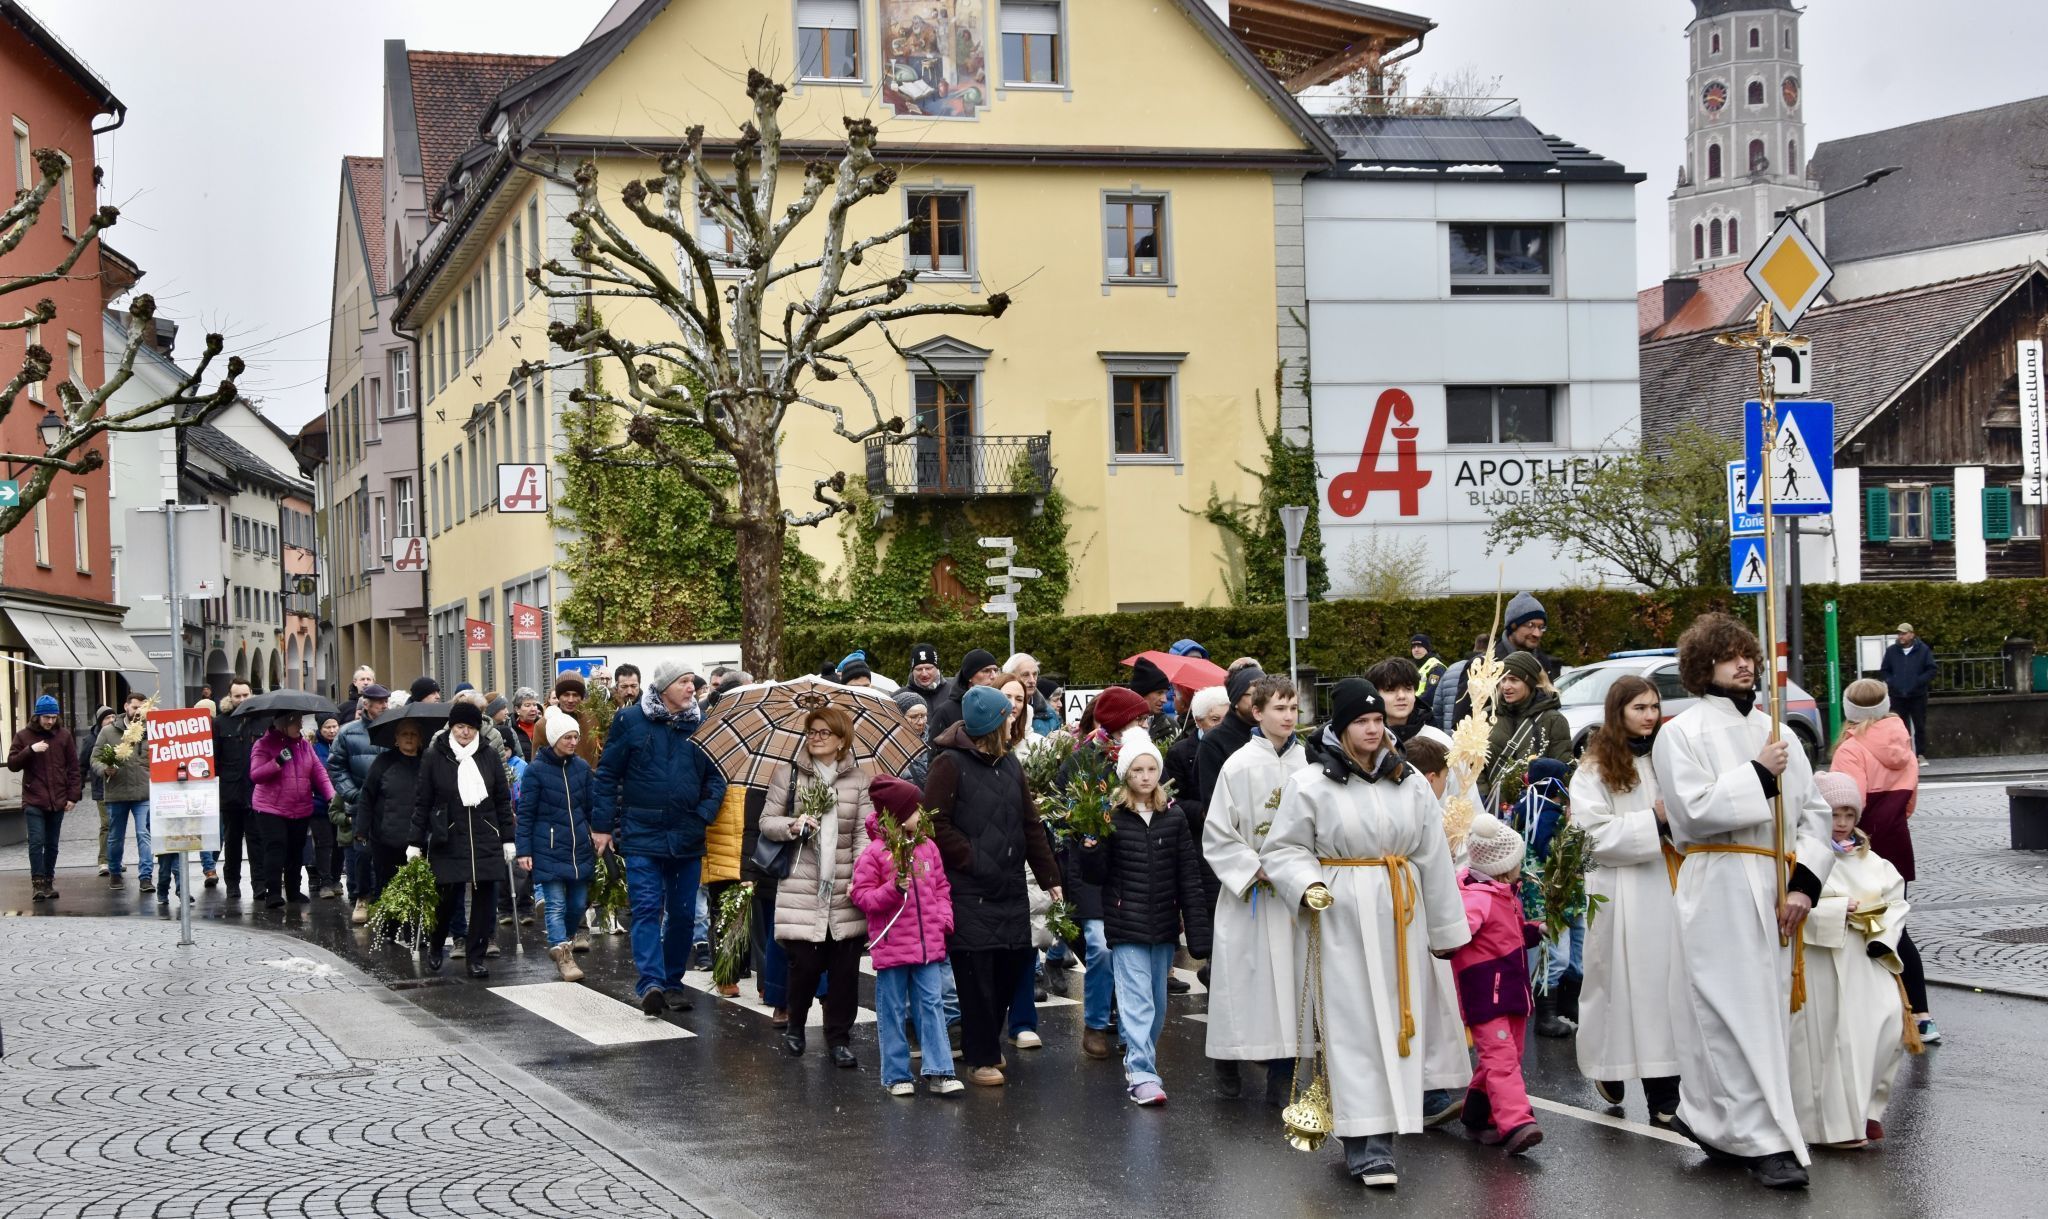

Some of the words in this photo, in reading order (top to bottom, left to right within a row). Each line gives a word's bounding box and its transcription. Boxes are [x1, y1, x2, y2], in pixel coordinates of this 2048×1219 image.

[2026, 348, 2041, 497] Kunstausstellung
[1738, 515, 1765, 528] Zone
[146, 715, 211, 741] Kronen
[149, 739, 214, 764] Zeitung
